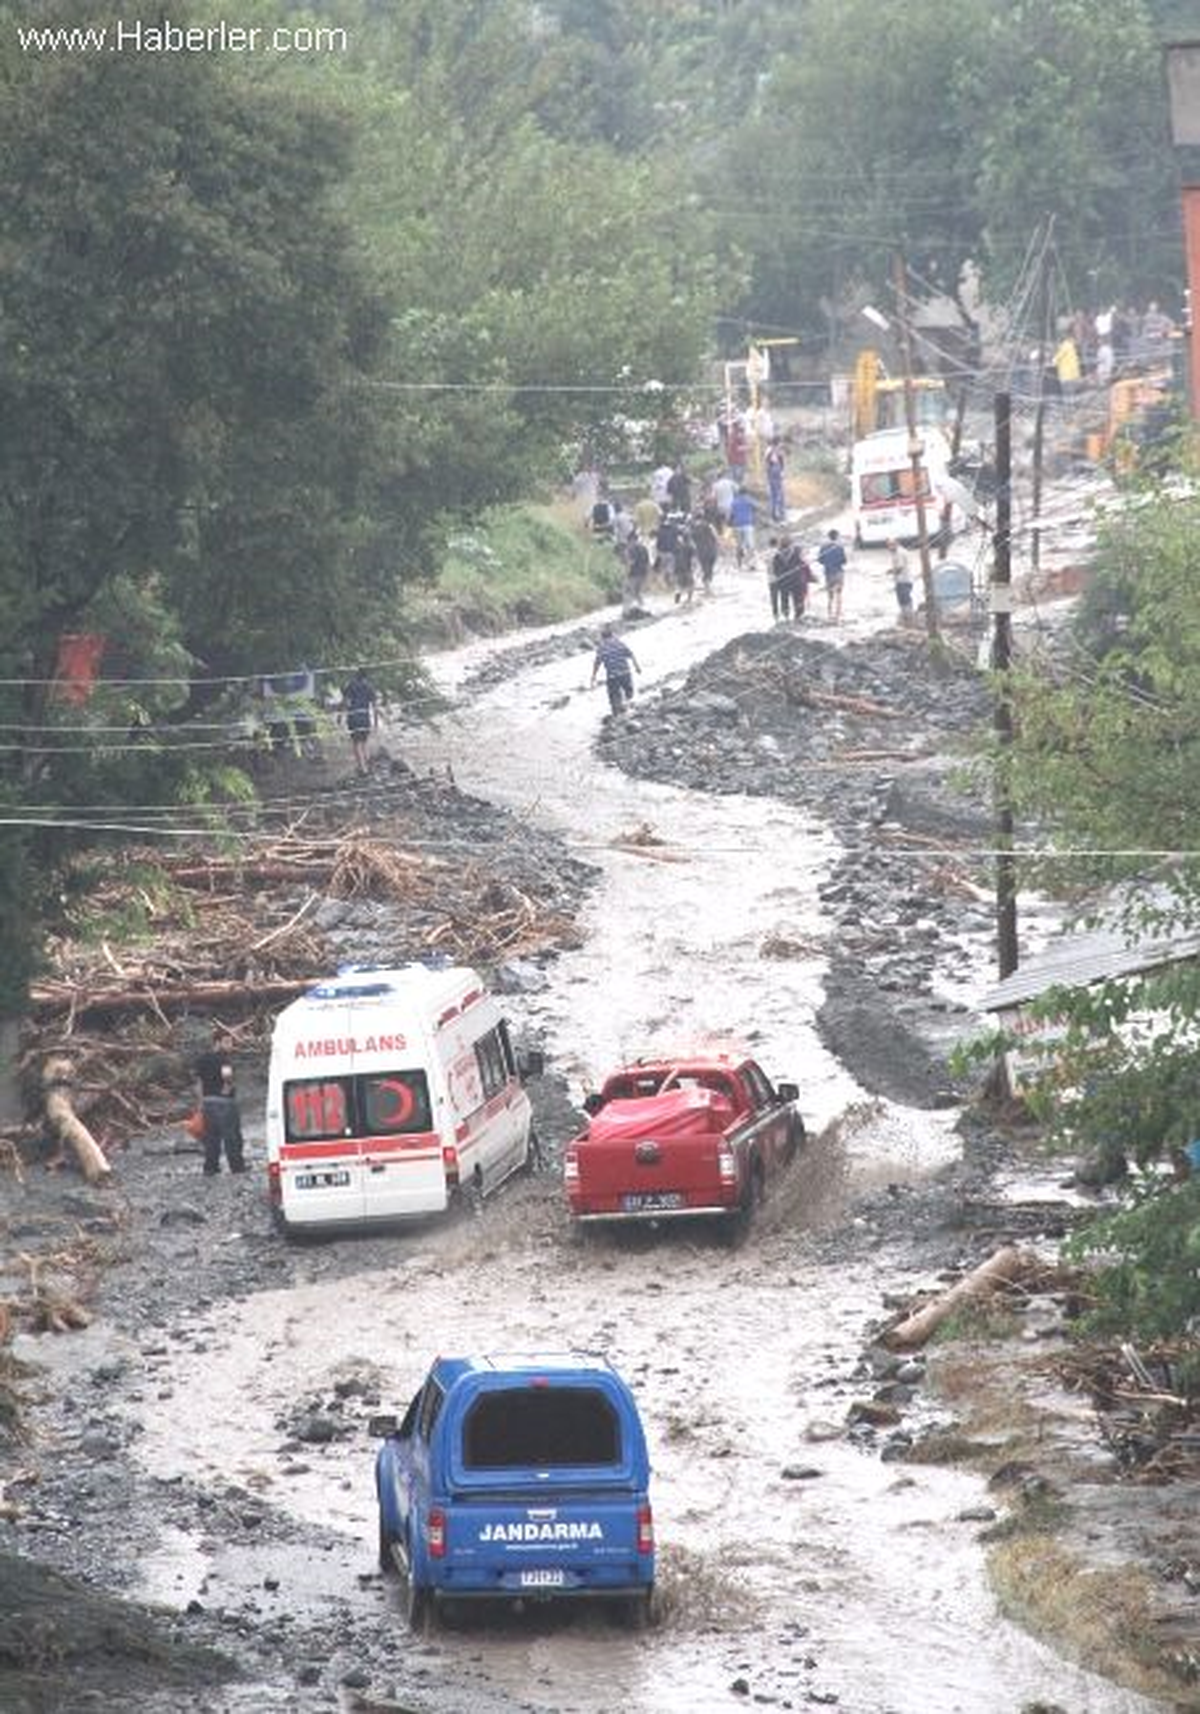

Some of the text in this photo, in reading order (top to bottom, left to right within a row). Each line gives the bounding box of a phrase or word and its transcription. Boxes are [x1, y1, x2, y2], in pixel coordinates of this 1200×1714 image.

[294, 1033, 407, 1058] AMBULANS
[294, 1083, 342, 1131] 112
[479, 1522, 604, 1541] JANDARMA
